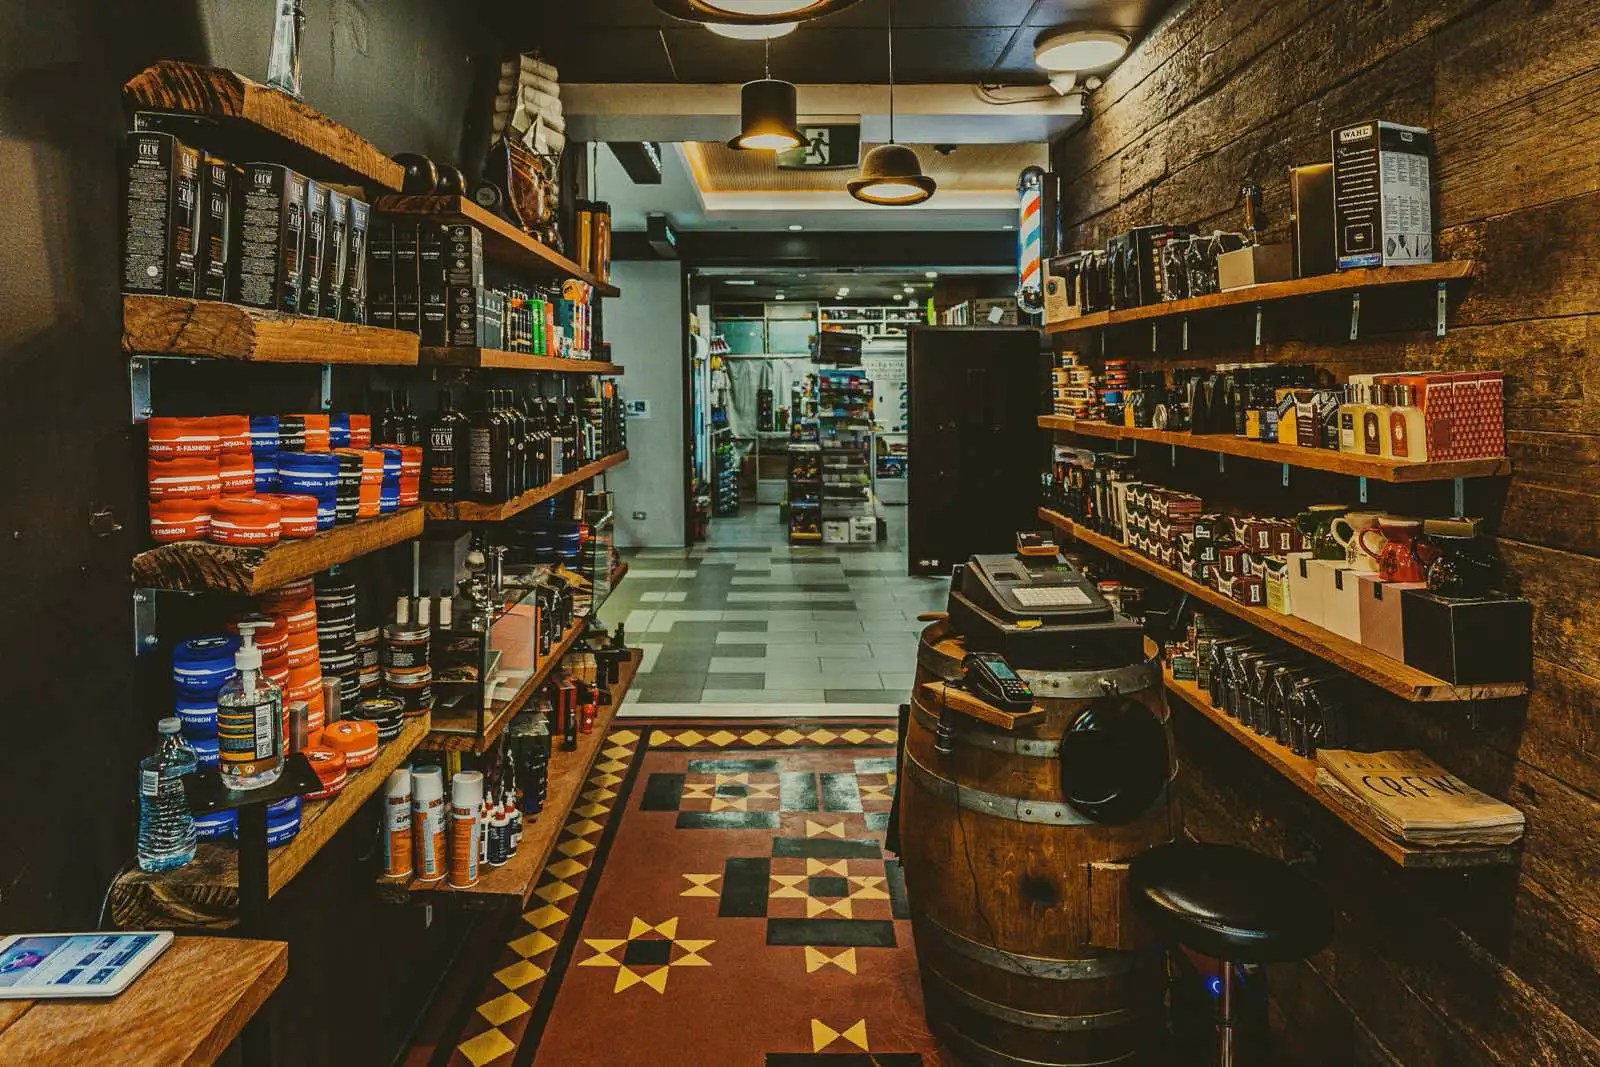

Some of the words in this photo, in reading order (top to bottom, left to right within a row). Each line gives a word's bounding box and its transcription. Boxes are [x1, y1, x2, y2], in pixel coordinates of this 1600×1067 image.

[1342, 128, 1370, 139] WAHL
[139, 143, 159, 156] CREW
[254, 173, 273, 185] CREW
[431, 433, 453, 446] CREW
[1361, 775, 1467, 799] CREW
